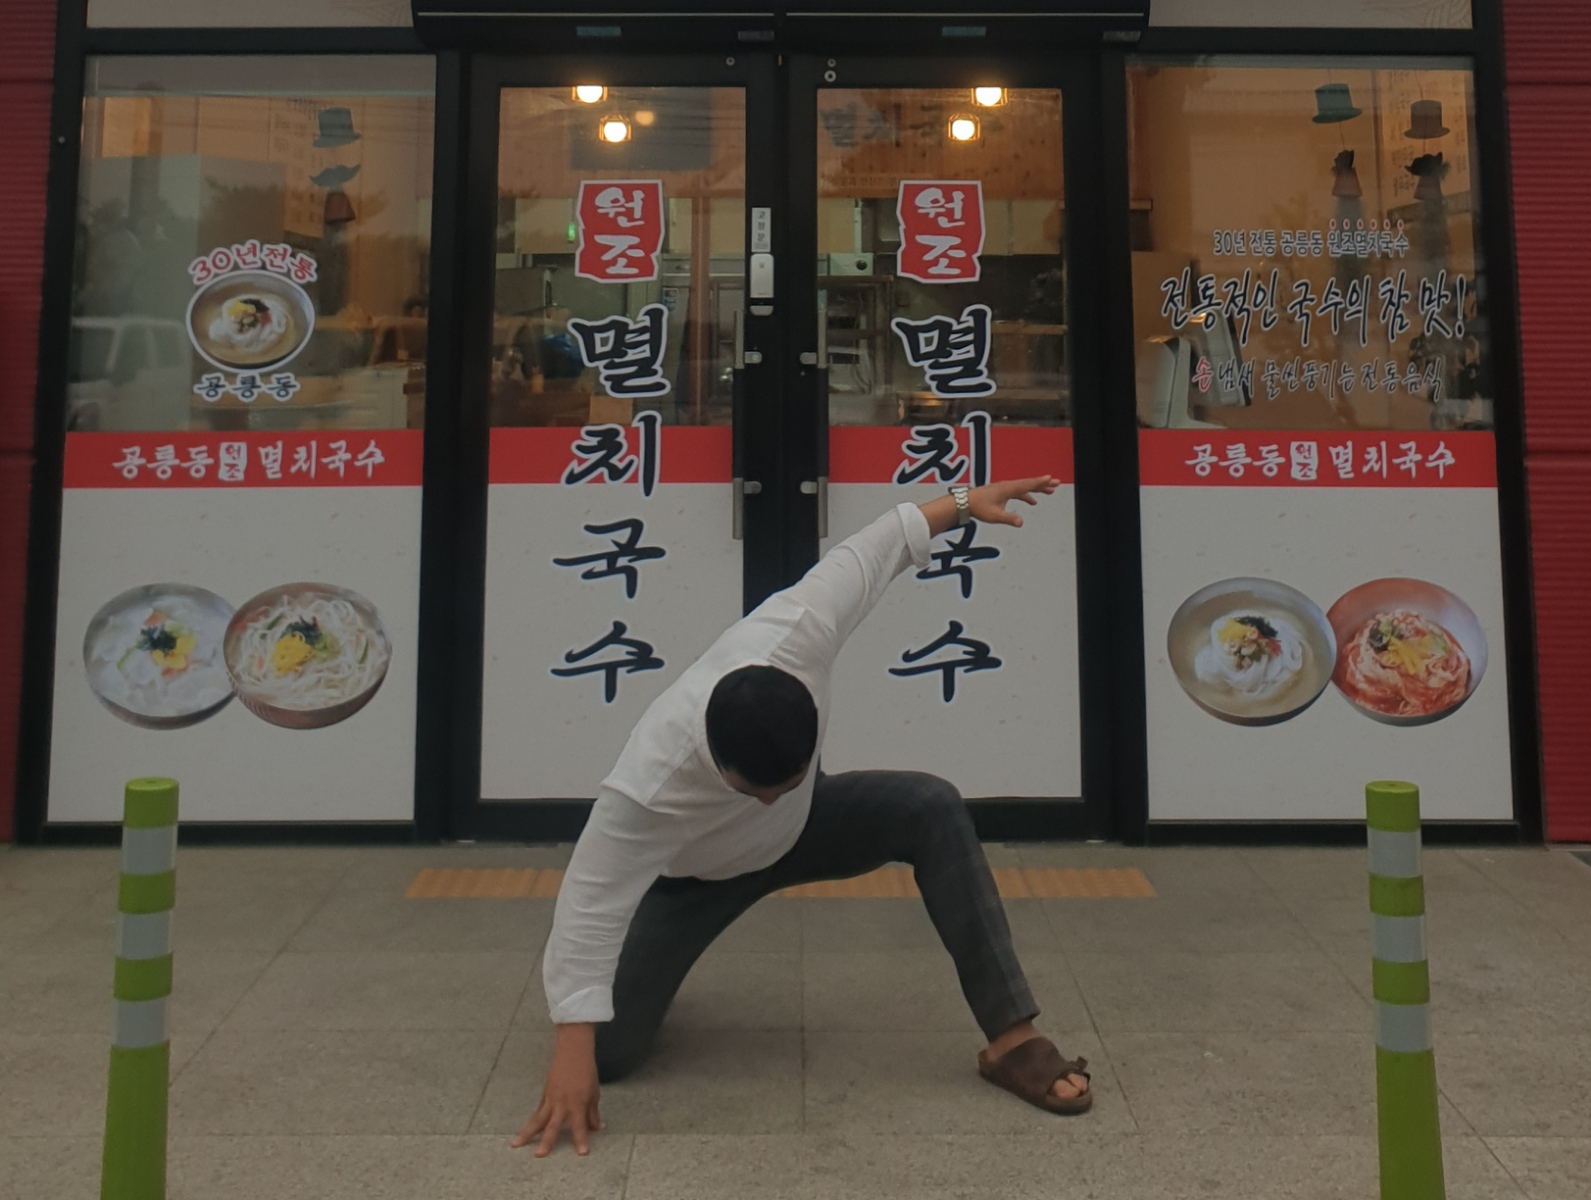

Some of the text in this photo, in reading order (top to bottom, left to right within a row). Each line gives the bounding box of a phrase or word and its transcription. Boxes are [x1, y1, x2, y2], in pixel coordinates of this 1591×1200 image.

[594, 187, 645, 275] 원조
[915, 187, 965, 275] 원조
[1213, 229, 1410, 257] 30년 전통 공릉동 원조멸치국수
[189, 240, 317, 284] 30년전통
[1161, 268, 1279, 346] 전통적인
[1287, 274, 1372, 347] 국수의
[195, 373, 300, 401] 공릉동
[112, 444, 215, 480] 공릉동
[258, 440, 386, 480] 멸치국수
[1185, 442, 1286, 478] 공릉동
[1328, 441, 1456, 479] 멸치국수
[551, 304, 670, 703] 멸치국수
[889, 304, 1002, 703] 멸치국수
